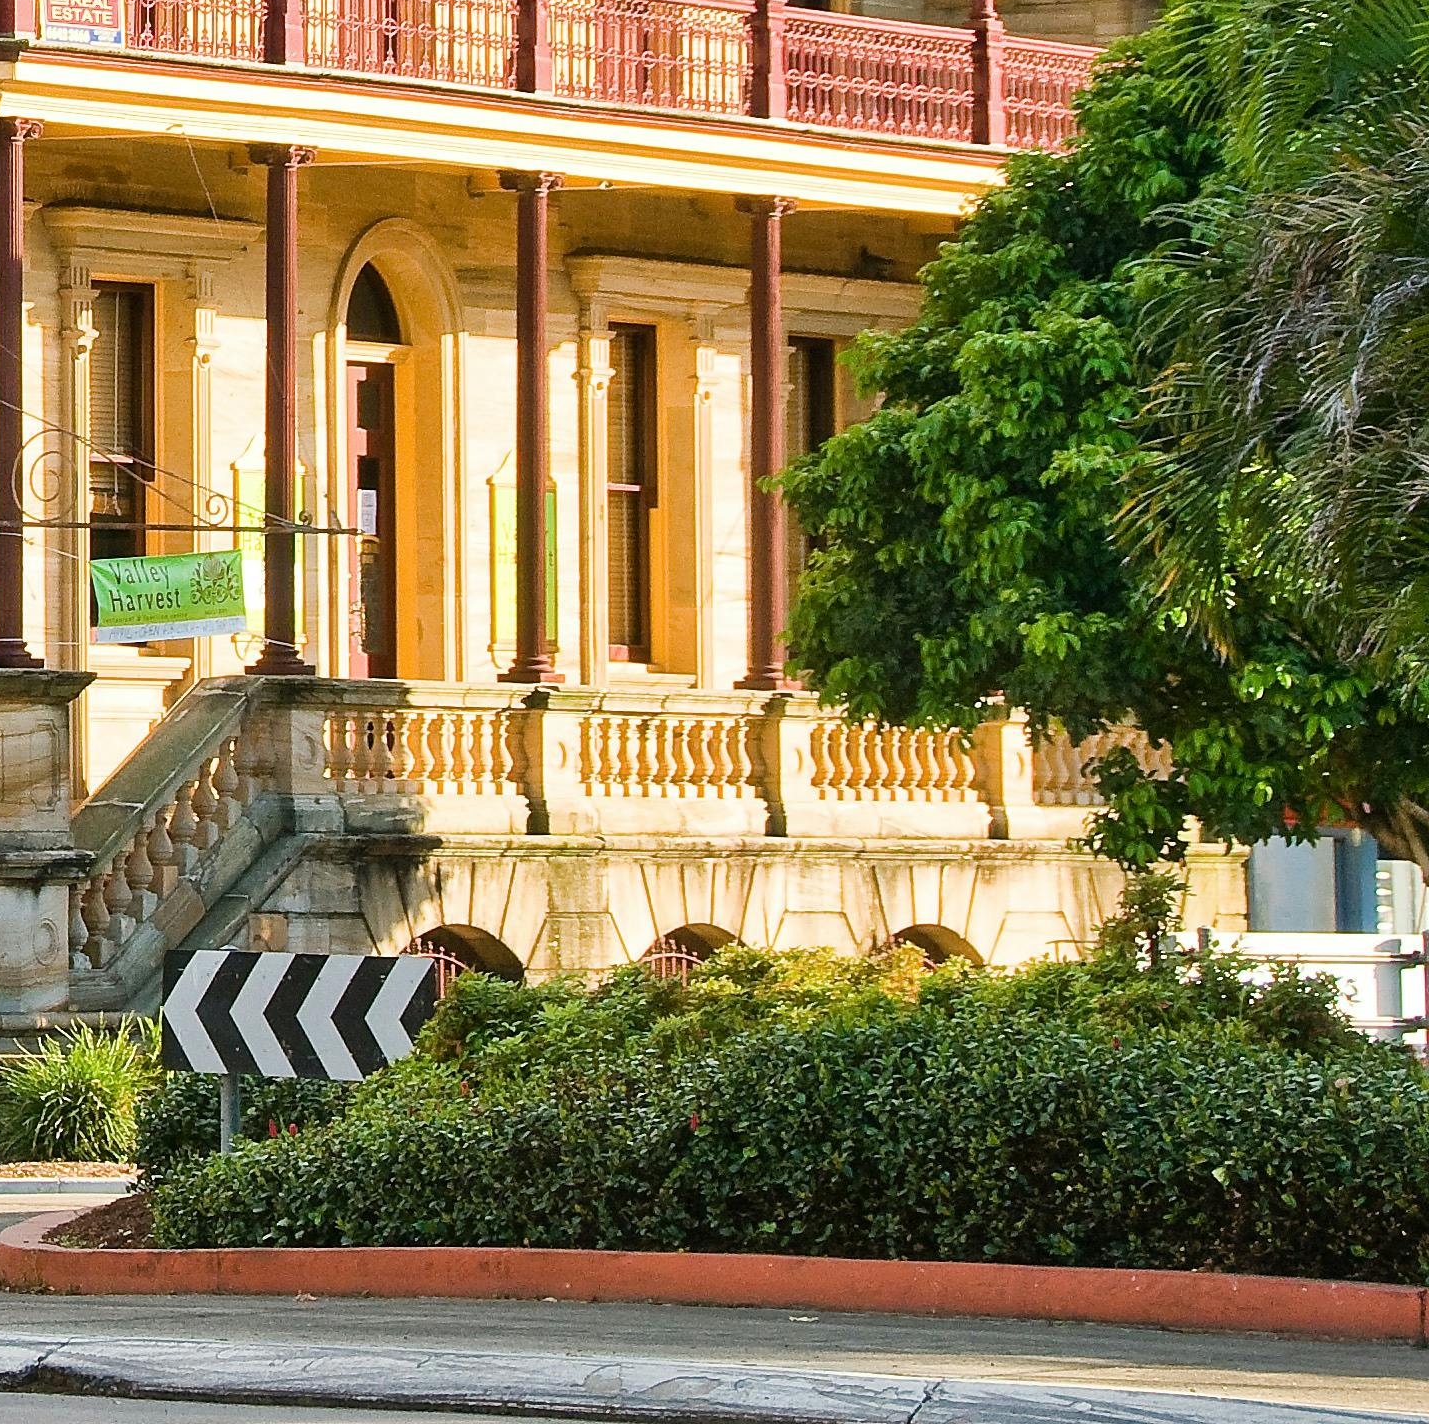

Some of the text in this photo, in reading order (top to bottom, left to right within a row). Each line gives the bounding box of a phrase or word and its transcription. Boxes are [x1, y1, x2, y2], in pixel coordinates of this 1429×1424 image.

[51, 6, 113, 25] ESTATE
[108, 559, 169, 589] Valley
[109, 588, 181, 612] Harvest
